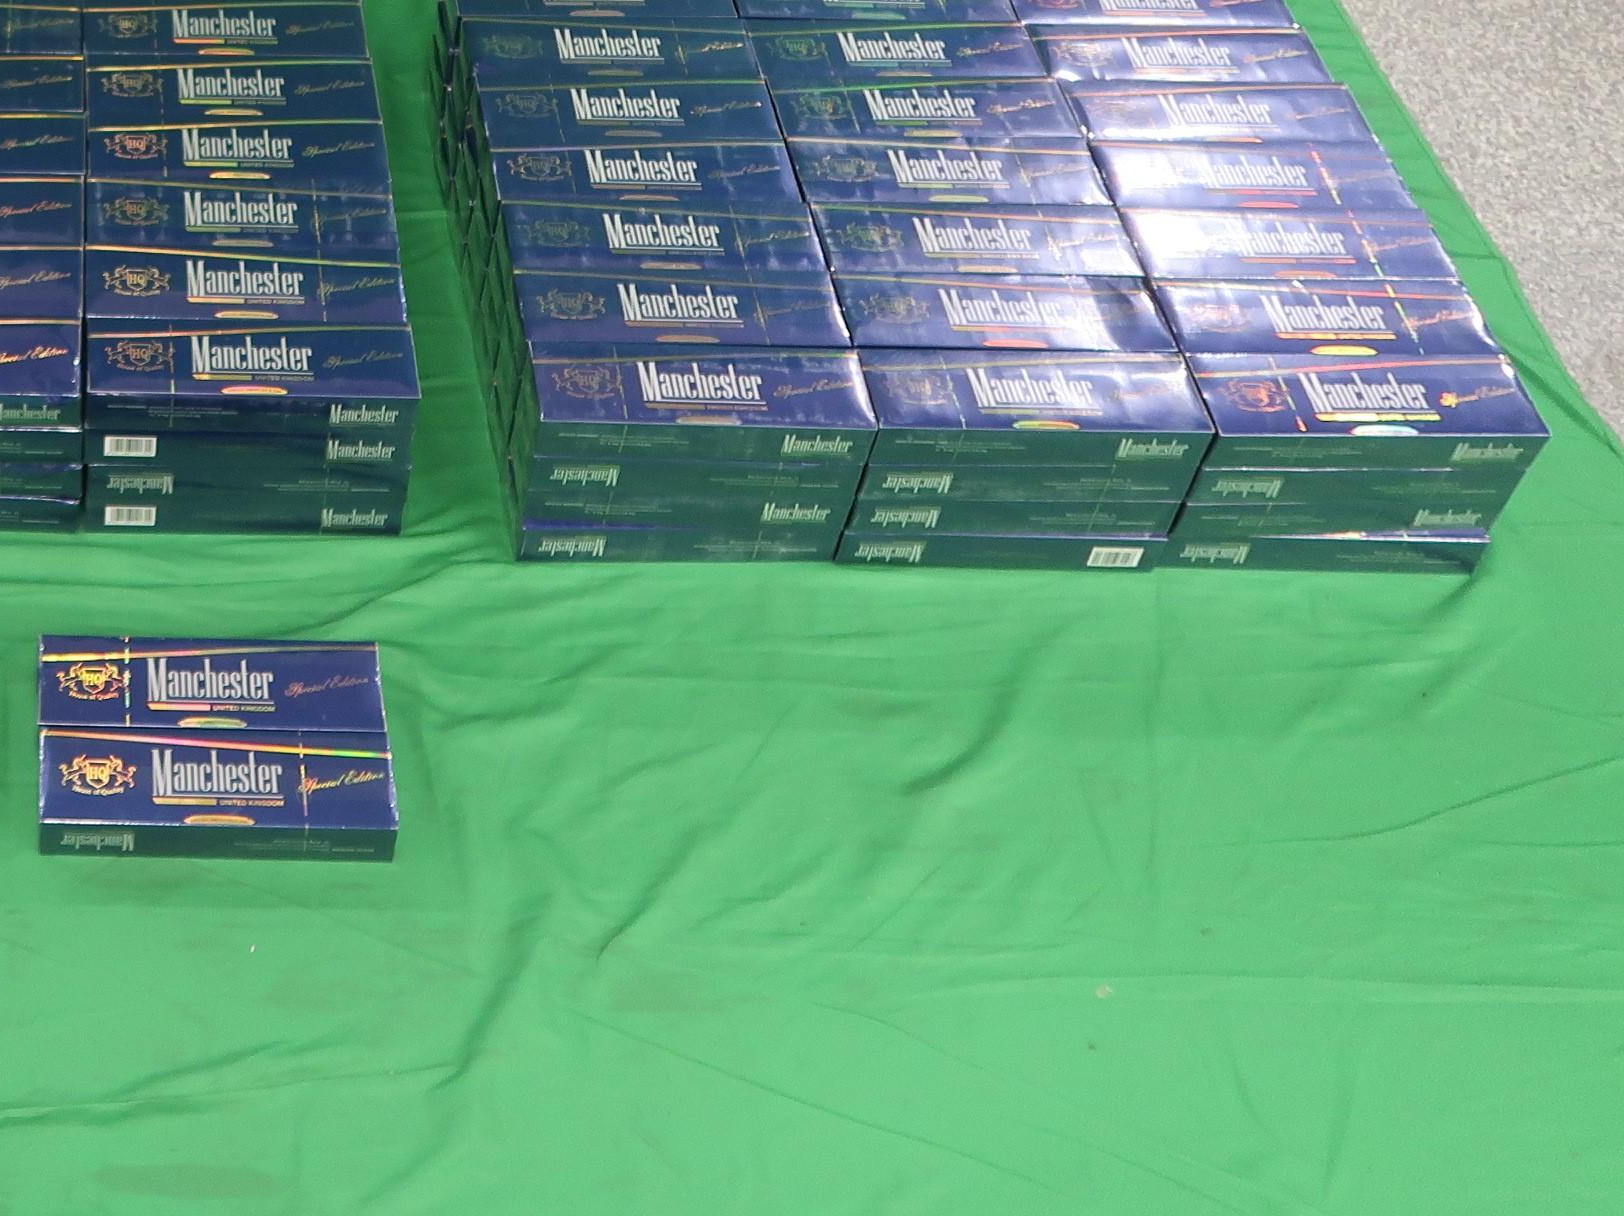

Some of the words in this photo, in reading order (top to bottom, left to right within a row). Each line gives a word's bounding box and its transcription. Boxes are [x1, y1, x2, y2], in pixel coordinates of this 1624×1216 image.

[172, 9, 276, 36] Manchester
[554, 28, 661, 58] Manchester
[837, 32, 945, 61] Manchester
[1123, 37, 1232, 68] Manchester
[177, 68, 285, 98] Manchester
[571, 88, 680, 118] Manchester
[863, 89, 976, 119] Manchester
[182, 128, 292, 160] Manchester
[584, 149, 698, 182] Manchester
[888, 149, 1004, 182] Manchester
[184, 191, 298, 225] Manchester
[603, 213, 720, 248] Manchester
[912, 217, 1032, 252] Manchester
[186, 260, 304, 296] Manchester
[617, 284, 739, 321] Manchester
[1262, 295, 1384, 333] Manchester
[30, 346, 69, 360] Edition
[191, 336, 312, 372] Manchester
[637, 362, 762, 402] Manchester
[966, 368, 1094, 408] Manchester
[1298, 372, 1428, 414] Manchester
[329, 403, 400, 424] Manchester
[327, 440, 396, 461] Manchester
[781, 434, 853, 455] Manchester
[147, 657, 274, 701] Manchester
[285, 681, 328, 698] Special
[328, 674, 370, 690] Edition
[152, 749, 283, 797] Manchester
